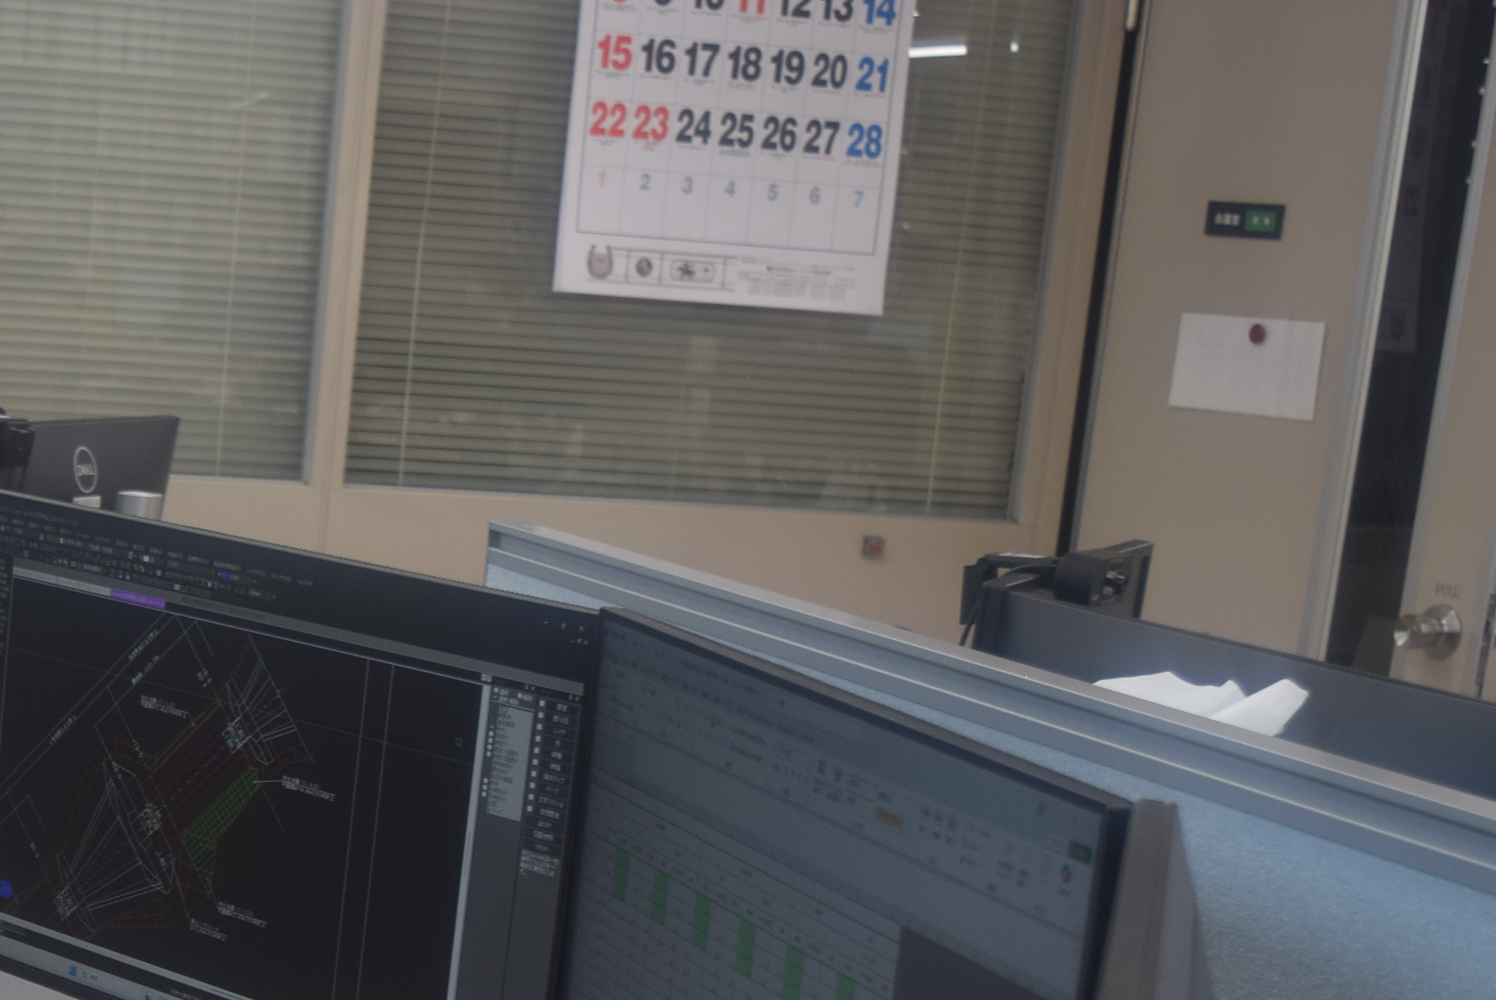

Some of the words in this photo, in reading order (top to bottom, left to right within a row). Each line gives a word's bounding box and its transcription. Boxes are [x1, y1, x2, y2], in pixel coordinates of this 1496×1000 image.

[821, 0, 854, 22] 13
[864, 0, 897, 26] 14
[598, 35, 633, 71] 15
[641, 38, 676, 74] 16
[685, 42, 720, 77] 17
[728, 46, 763, 81] 18
[771, 49, 805, 85] 19
[812, 53, 847, 89] 20
[856, 57, 890, 93] 21
[590, 101, 627, 138] 22
[632, 105, 670, 141] 23
[675, 108, 711, 144] 24
[718, 112, 754, 148] 25
[761, 116, 797, 152] 26
[803, 119, 840, 155] 27
[846, 123, 883, 159] 28
[598, 170, 607, 187] 1
[640, 173, 652, 191] 2
[681, 176, 694, 194] 3
[724, 180, 736, 198] 4
[767, 183, 779, 201] 5
[808, 186, 821, 204] 6
[854, 190, 865, 208] 7
[77, 464, 96, 476] DELL
